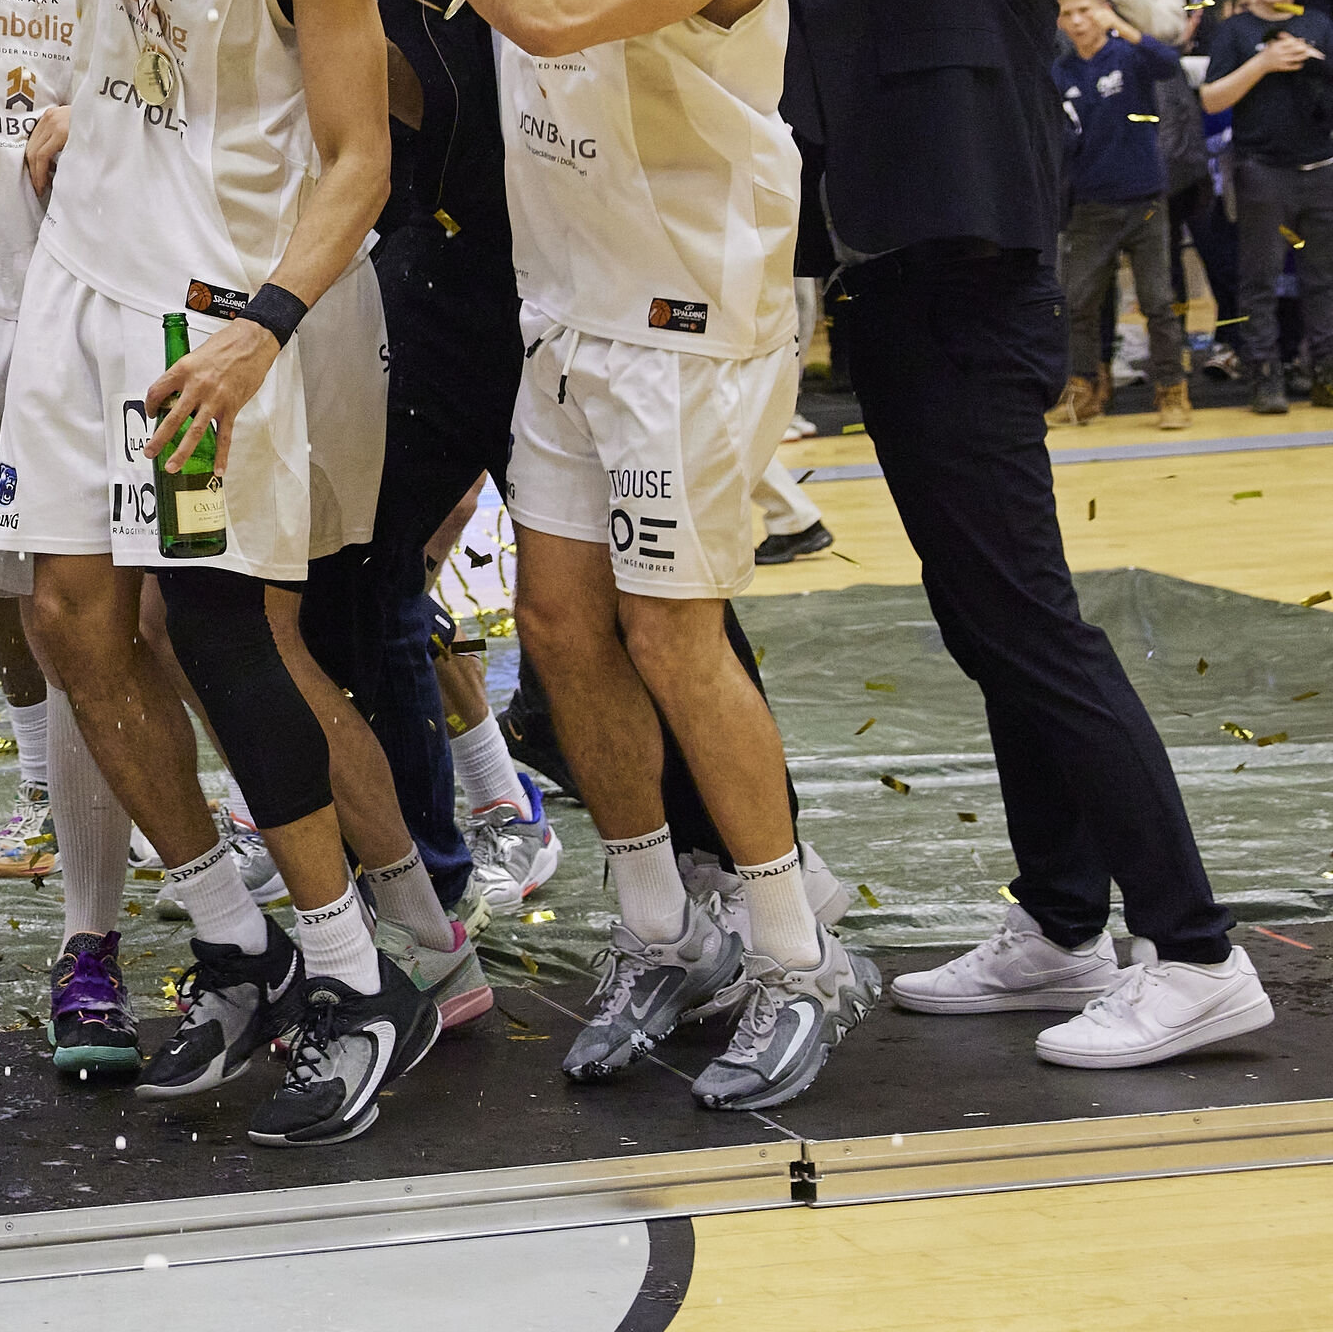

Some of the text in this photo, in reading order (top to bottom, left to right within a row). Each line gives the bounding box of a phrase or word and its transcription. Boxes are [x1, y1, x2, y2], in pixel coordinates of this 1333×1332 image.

[42, 53, 71, 62] NORDEA
[213, 295, 246, 309] SPALDING
[673, 308, 706, 320] SPALDING
[611, 509, 677, 552] OE
